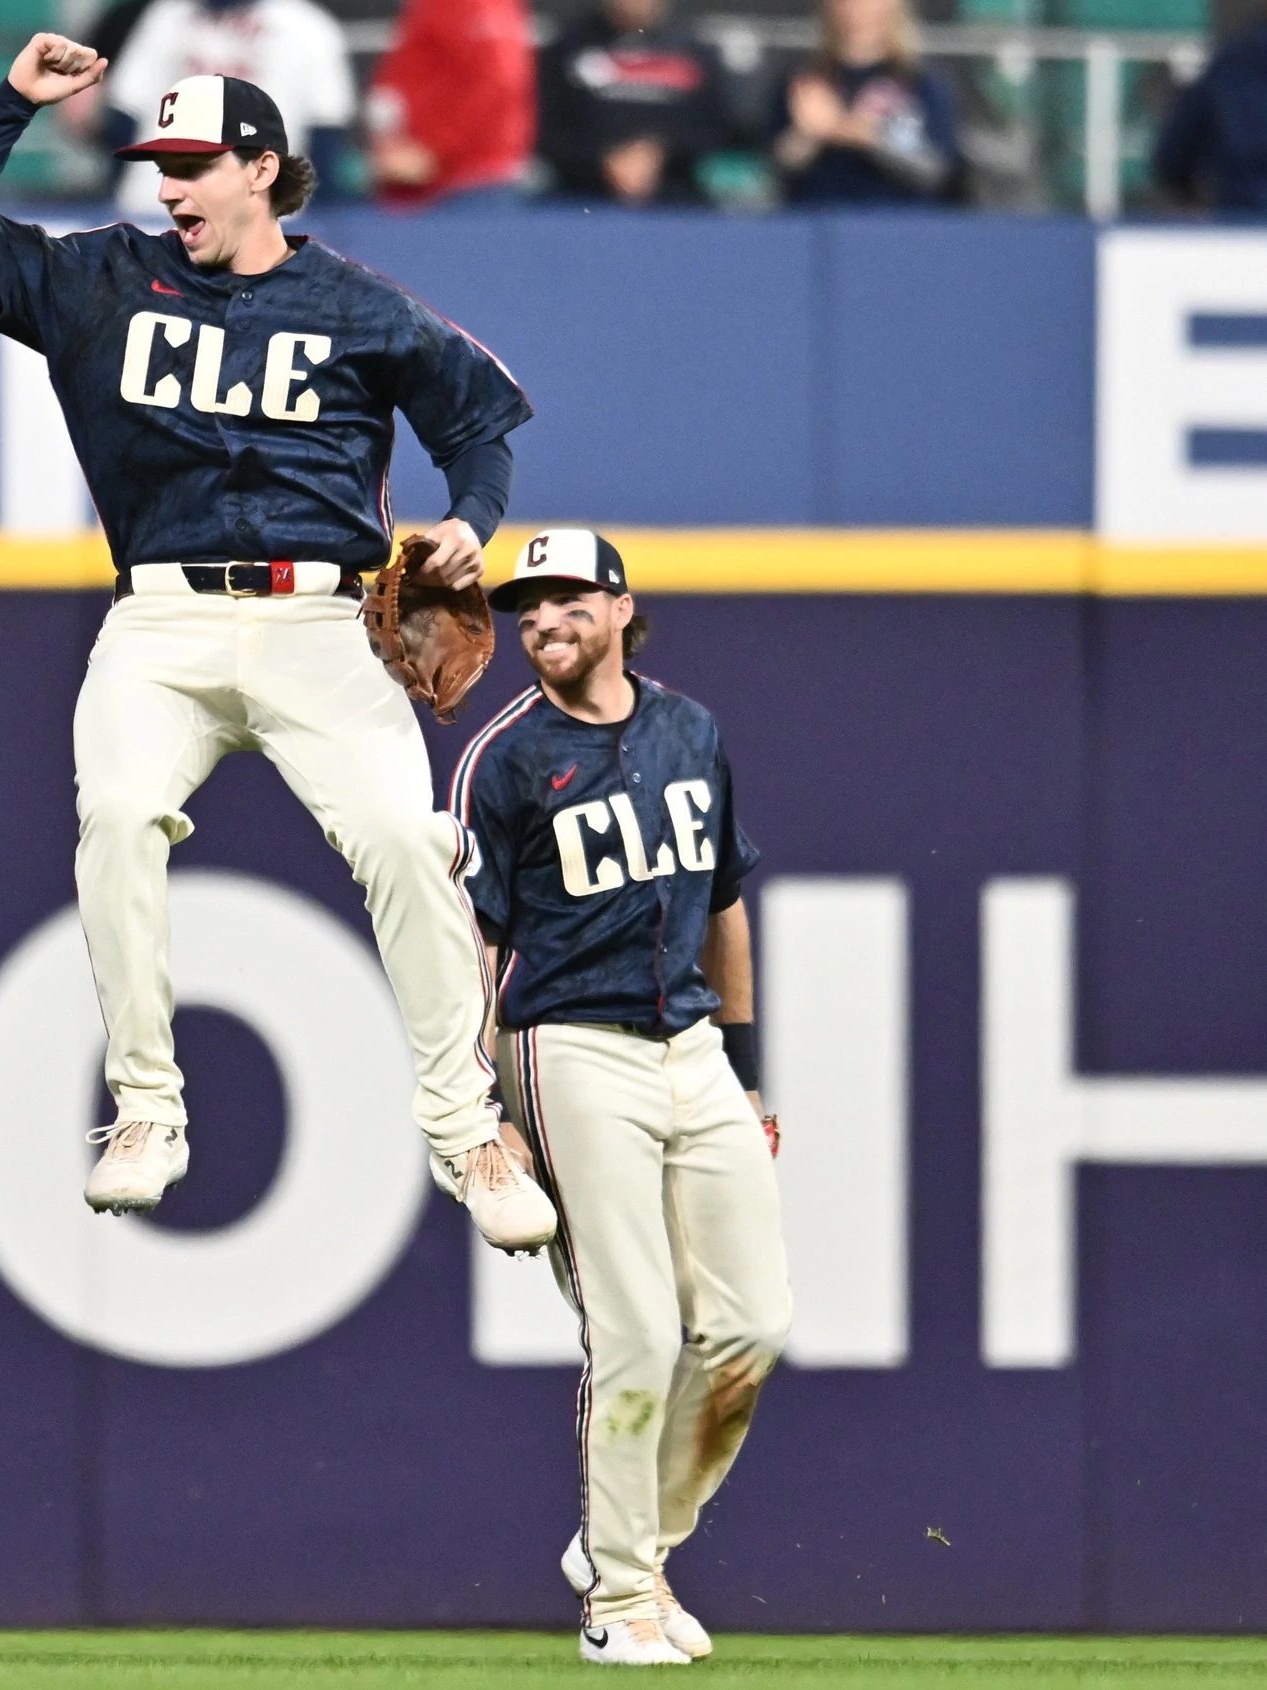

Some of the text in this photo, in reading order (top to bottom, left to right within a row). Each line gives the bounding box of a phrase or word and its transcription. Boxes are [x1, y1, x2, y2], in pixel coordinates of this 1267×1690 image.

[157, 91, 180, 129] C
[119, 310, 332, 423] CLE
[526, 535, 550, 568] C
[552, 779, 716, 897] CLE
